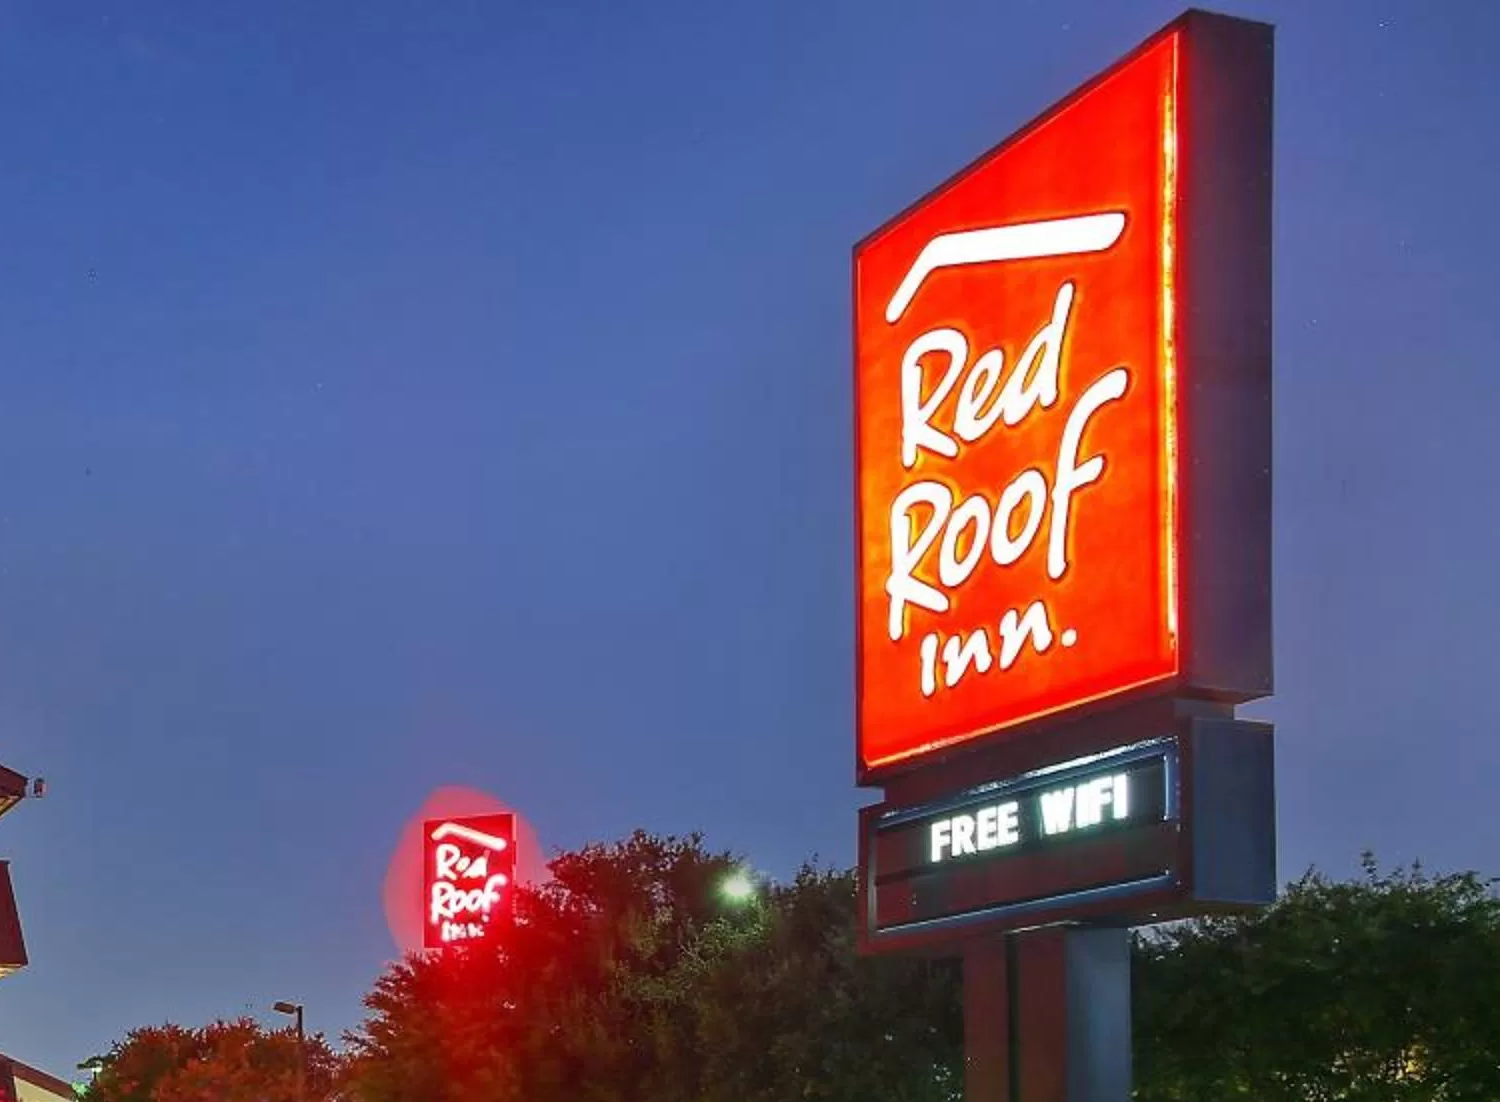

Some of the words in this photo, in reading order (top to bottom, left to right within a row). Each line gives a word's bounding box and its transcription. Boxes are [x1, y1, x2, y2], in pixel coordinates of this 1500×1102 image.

[901, 281, 1076, 469] Red
[886, 367, 1129, 641] Roof
[920, 600, 1078, 697] Inn.
[435, 843, 491, 881] Red
[929, 800, 1020, 863] FREE
[430, 872, 507, 926] Roof
